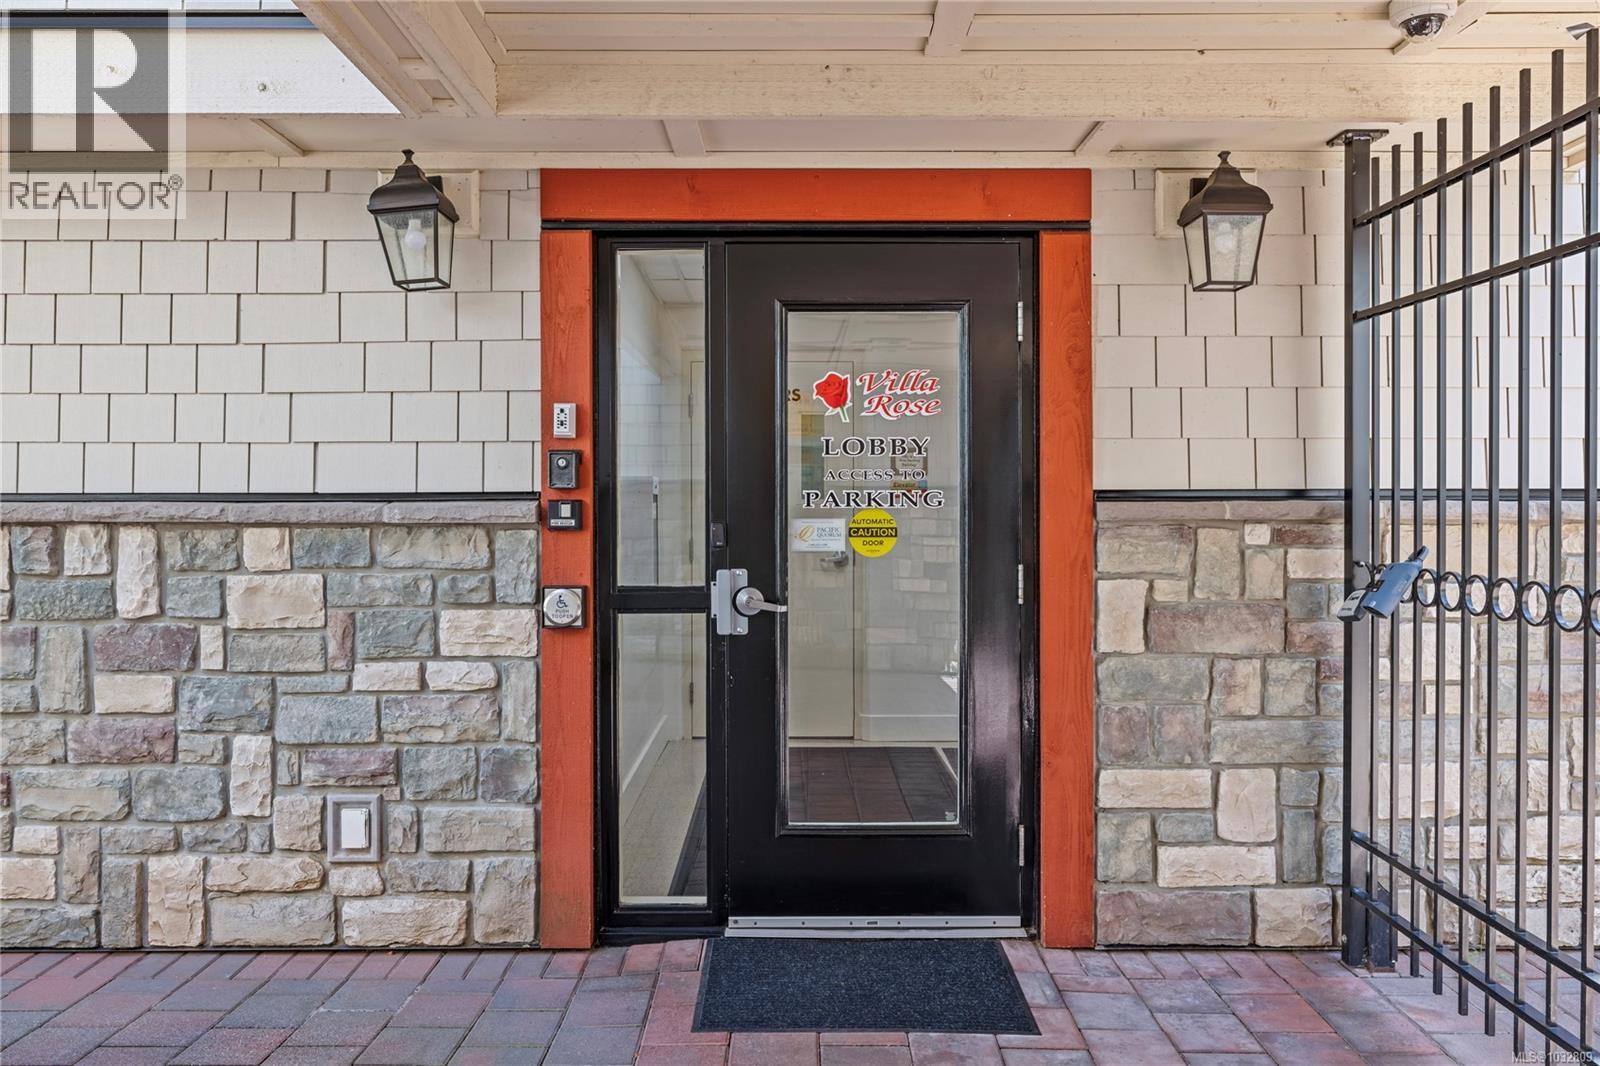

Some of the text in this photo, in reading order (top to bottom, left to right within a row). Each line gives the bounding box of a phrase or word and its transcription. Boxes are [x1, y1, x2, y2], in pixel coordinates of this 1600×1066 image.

[856, 368, 941, 395] Villa
[860, 394, 942, 421] Rose
[821, 436, 931, 457] LOBBY
[824, 468, 927, 481] ACCESS TO
[802, 489, 945, 509] PARKING
[851, 518, 894, 526] AUTOMATIC
[850, 528, 896, 537] CAUTION
